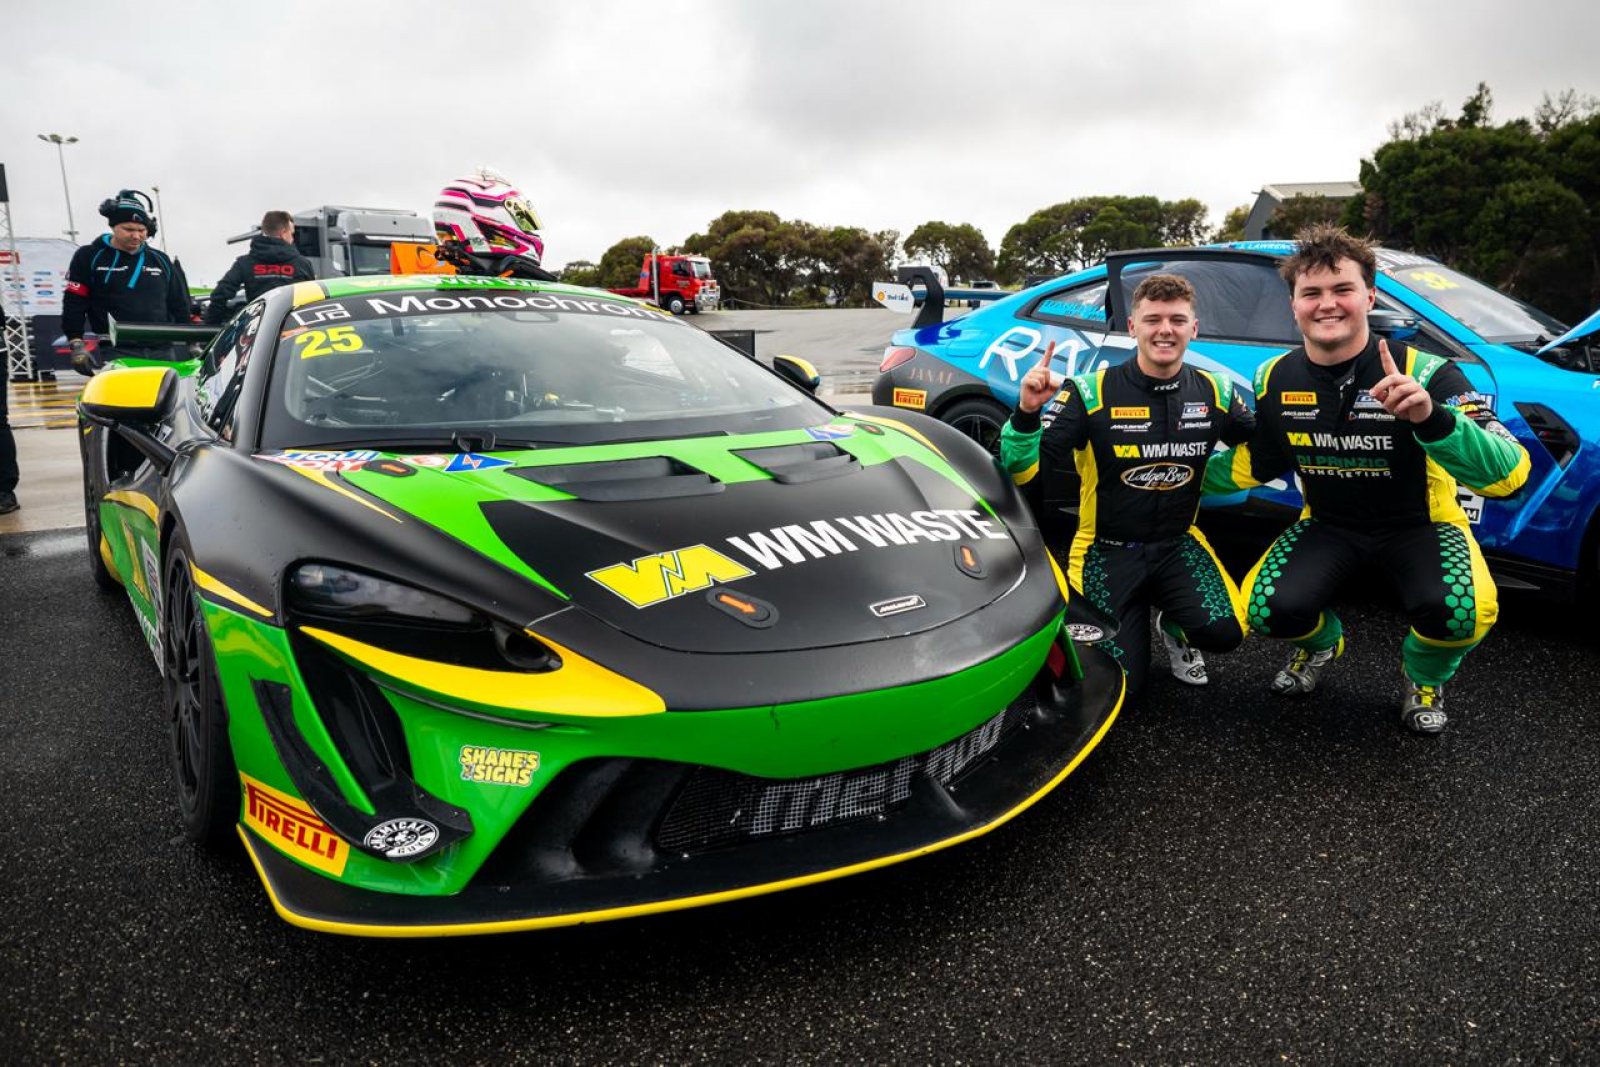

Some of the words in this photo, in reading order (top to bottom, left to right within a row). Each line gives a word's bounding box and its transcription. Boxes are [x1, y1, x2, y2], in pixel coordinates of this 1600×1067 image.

[254, 264, 294, 275] SRO
[295, 326, 364, 360] 25
[895, 390, 925, 406] PIRELLI
[1142, 443, 1169, 458] WM
[1171, 442, 1207, 457] WASTE
[1314, 433, 1339, 450] WM
[1341, 436, 1393, 450] WASTE
[1315, 456, 1388, 468] PRINZIO
[725, 520, 854, 570] WM
[836, 510, 1009, 547] WASTE
[461, 746, 539, 770] SHANE'S
[473, 764, 532, 786] SIGNS
[246, 782, 339, 861] PIRELLI
